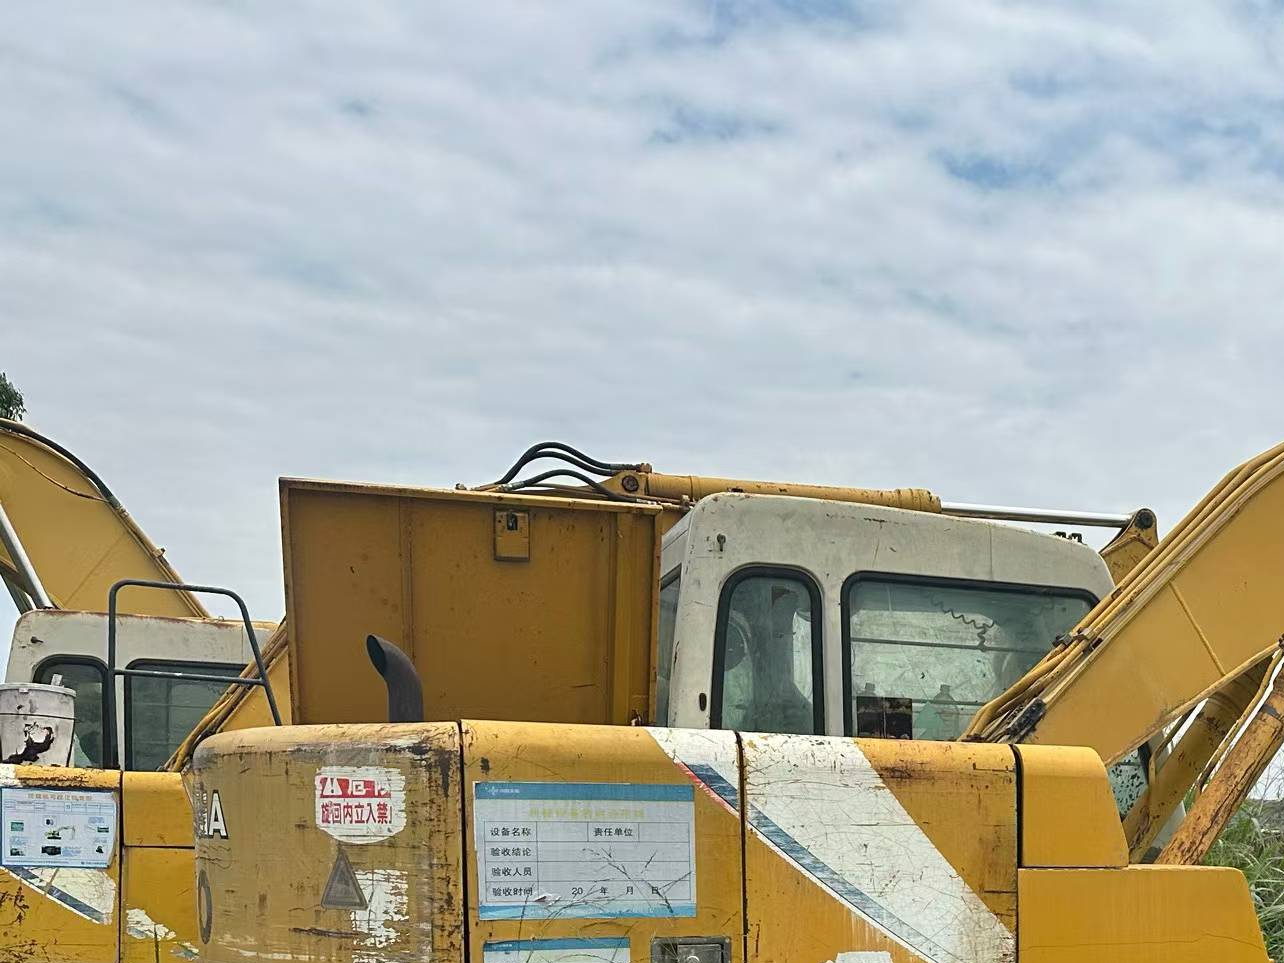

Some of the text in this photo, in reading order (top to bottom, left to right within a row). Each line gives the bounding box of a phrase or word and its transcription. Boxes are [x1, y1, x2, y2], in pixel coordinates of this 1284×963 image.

[321, 801, 393, 825] 旋回内立入禁
[490, 826, 532, 837] 设备名称
[593, 827, 634, 837] 责任单位
[490, 847, 532, 857] 验收结论
[491, 867, 532, 877] 验收人员
[492, 887, 533, 897] 验收时间
[571, 887, 583, 895] 20
